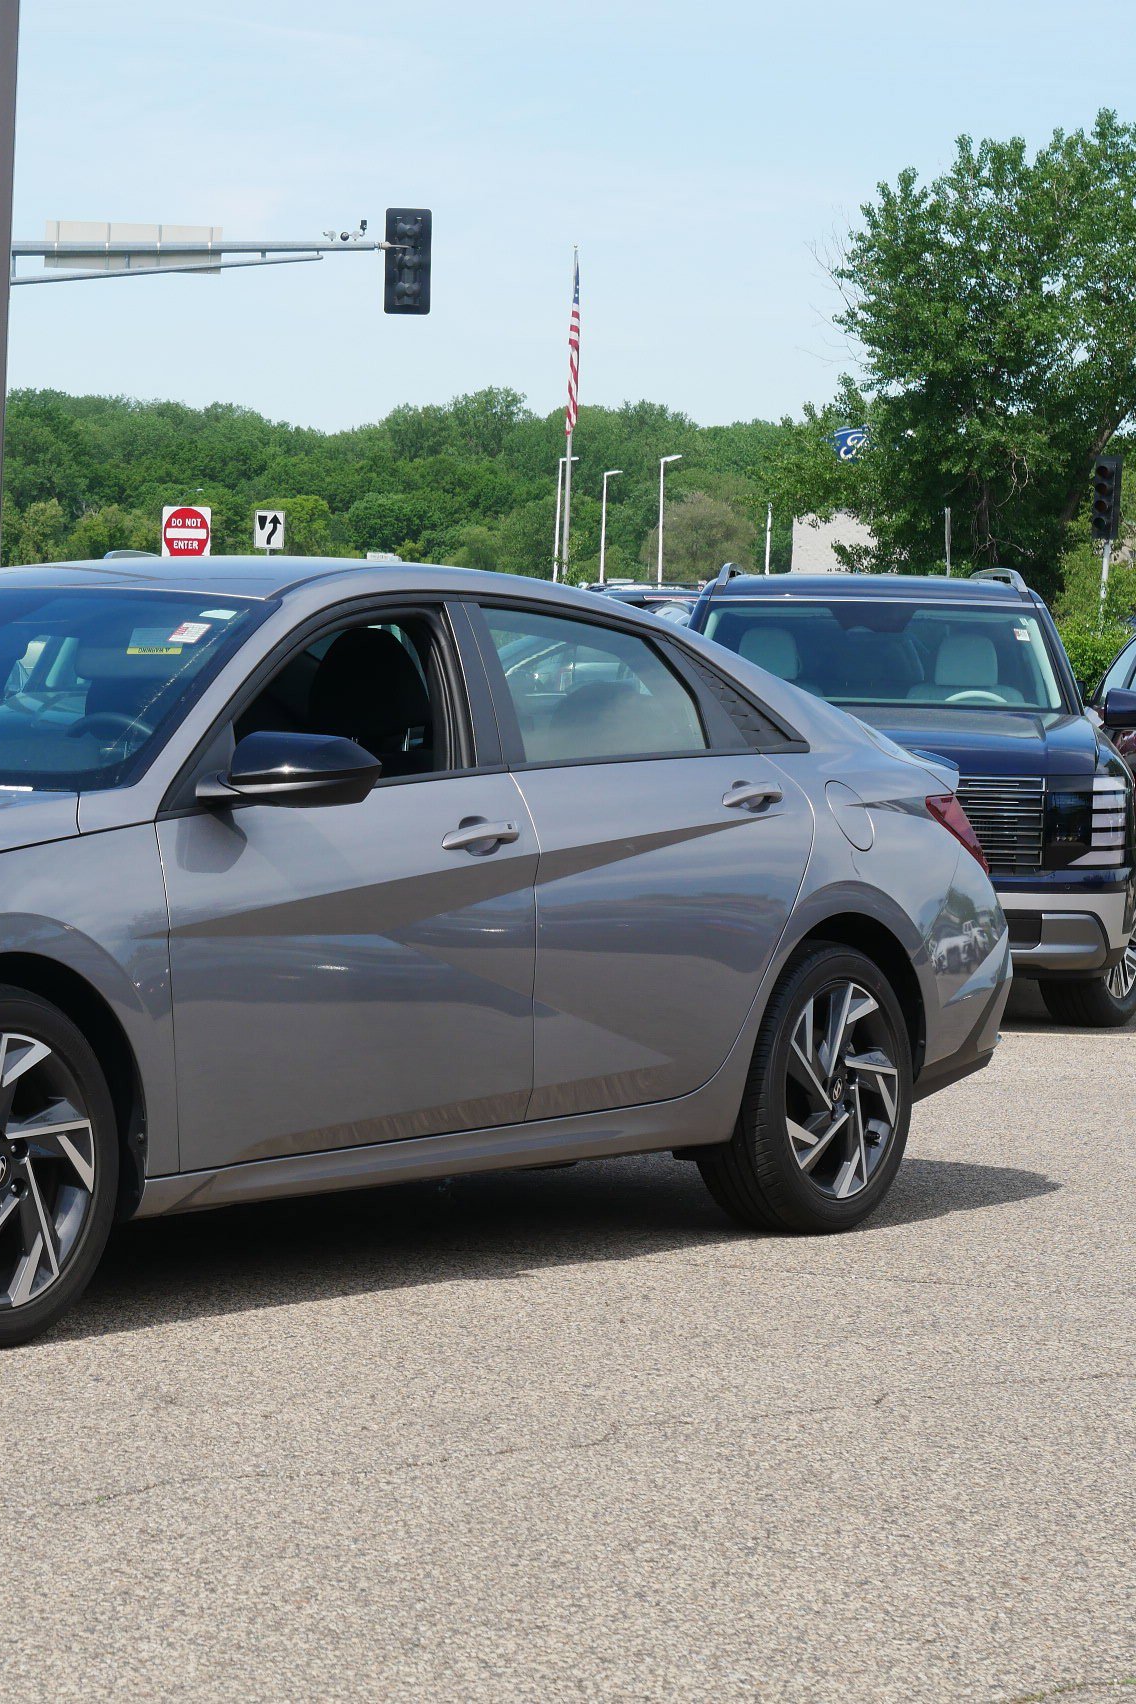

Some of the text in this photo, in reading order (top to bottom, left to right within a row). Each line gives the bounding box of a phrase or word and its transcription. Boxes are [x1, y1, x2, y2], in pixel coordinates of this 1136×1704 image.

[171, 518, 202, 527] DO NOT
[173, 540, 199, 550] ENTER
